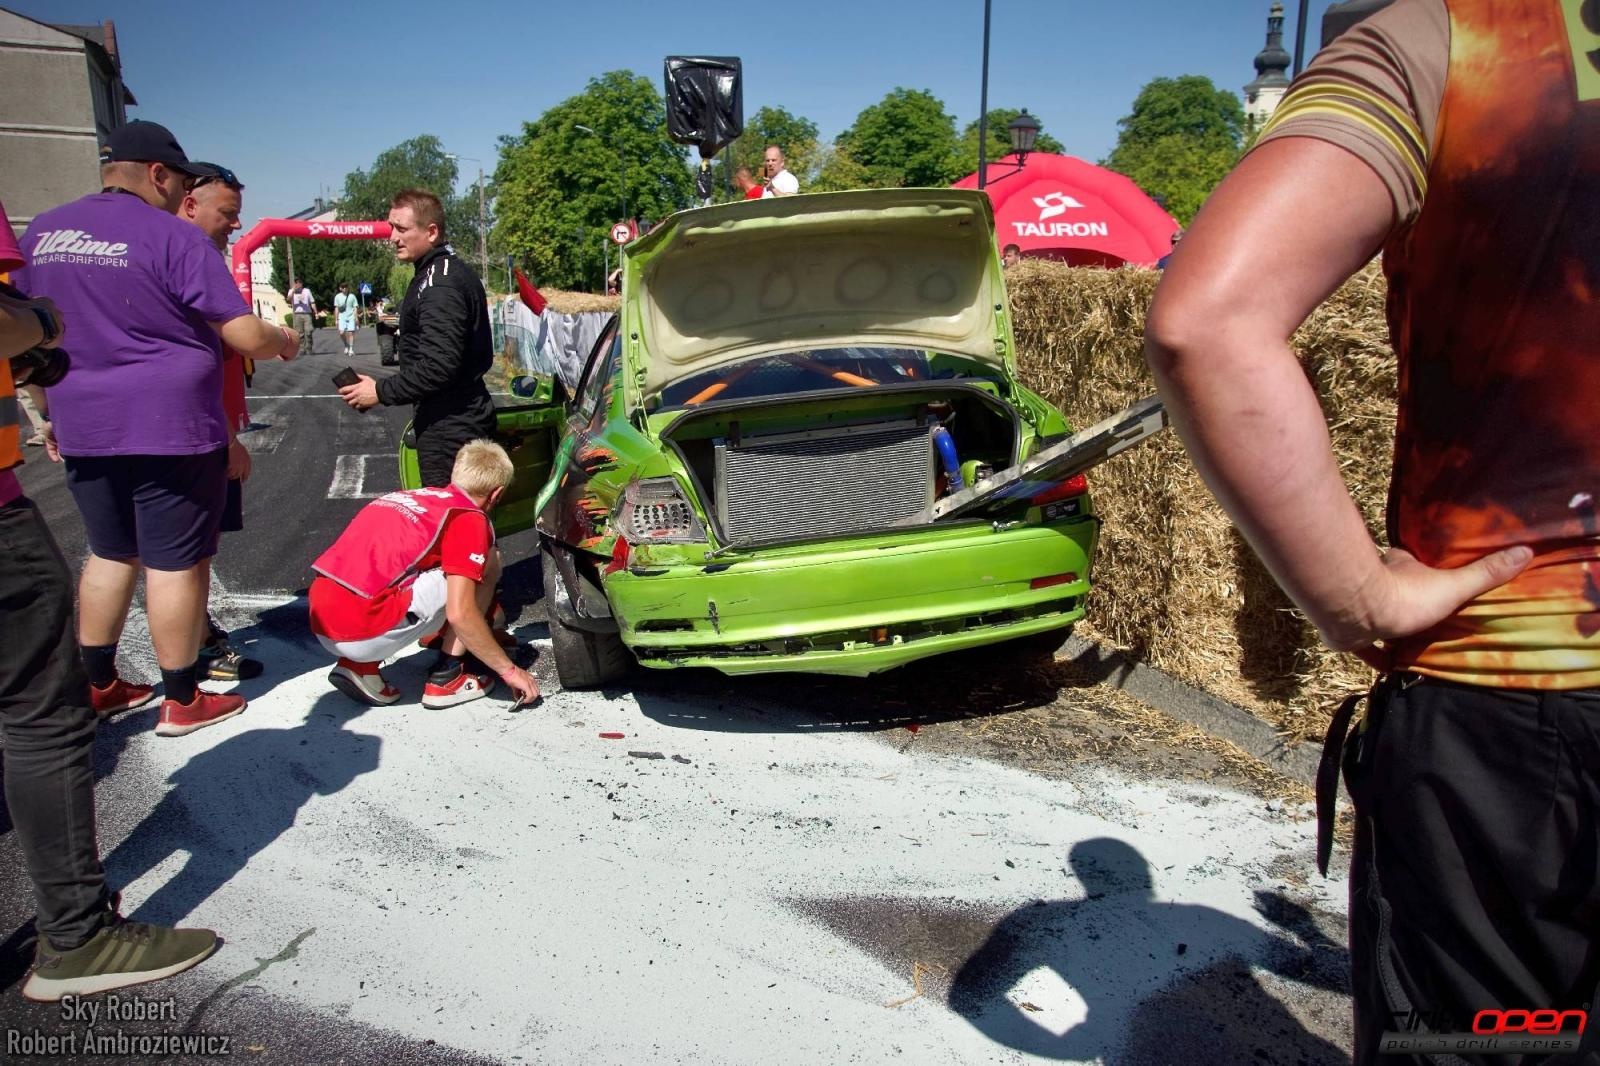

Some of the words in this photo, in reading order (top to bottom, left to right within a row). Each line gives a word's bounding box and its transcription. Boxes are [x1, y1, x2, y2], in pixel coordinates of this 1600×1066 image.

[325, 225, 374, 235] TAURON
[1011, 222, 1108, 236] TAURON
[32, 229, 128, 256] Ultime
